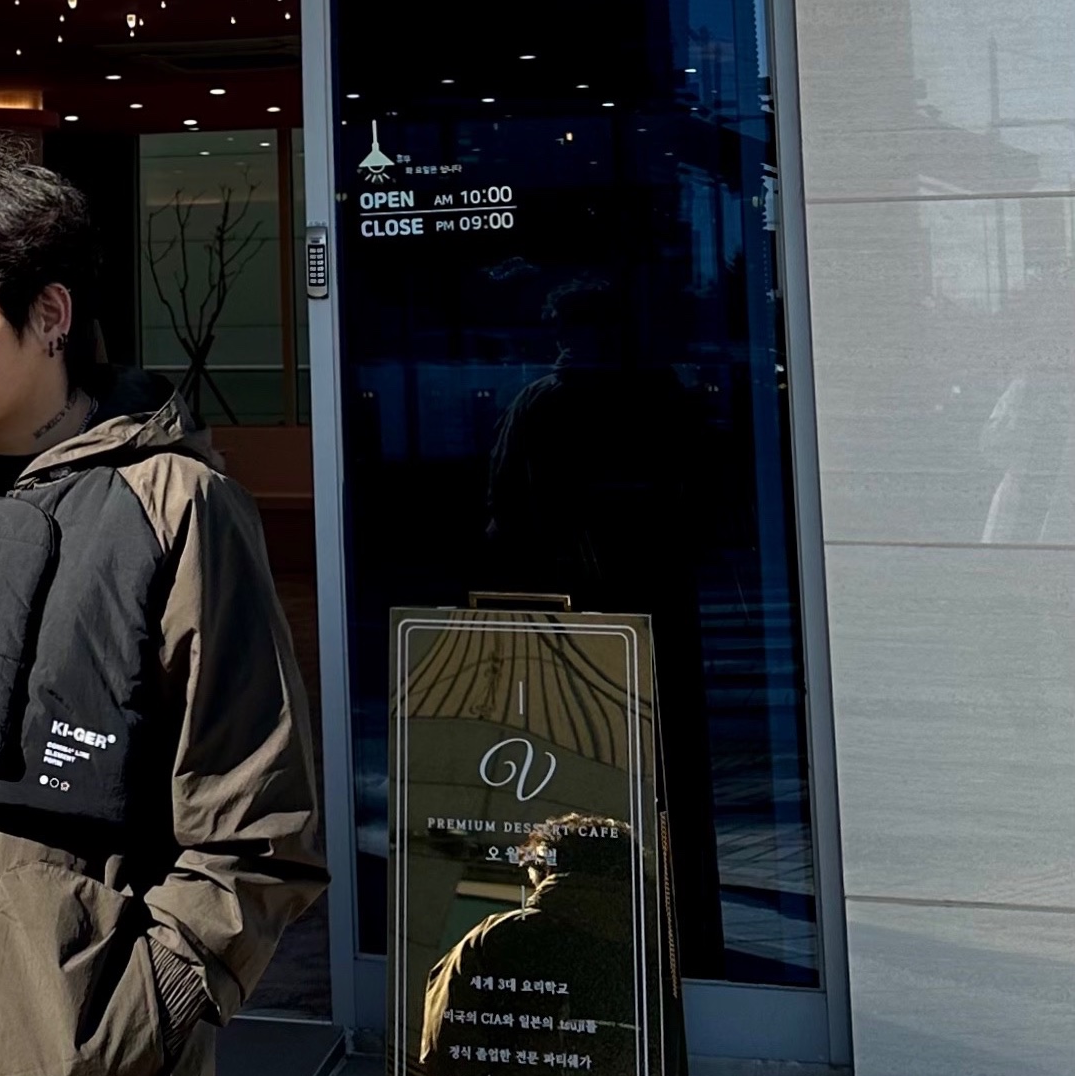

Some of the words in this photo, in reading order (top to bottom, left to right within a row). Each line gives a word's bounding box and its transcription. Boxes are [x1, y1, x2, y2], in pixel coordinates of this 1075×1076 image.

[360, 190, 414, 209] OPEN
[434, 194, 453, 205] AM
[460, 186, 513, 204] 10:00
[361, 218, 424, 237] CLOSE
[436, 220, 454, 231] PM
[459, 212, 514, 230] 09:00
[427, 817, 496, 832] PREMIUM
[578, 826, 619, 838] CAFE
[498, 977, 517, 992] 3대
[521, 979, 569, 994] 요리학교
[443, 1008, 477, 1024] 미국의
[481, 1012, 514, 1027] CIA와
[519, 1014, 553, 1031] 일본의
[449, 1045, 471, 1060] 정식
[476, 1047, 511, 1063] 졸업한
[516, 1050, 539, 1065] 전문
